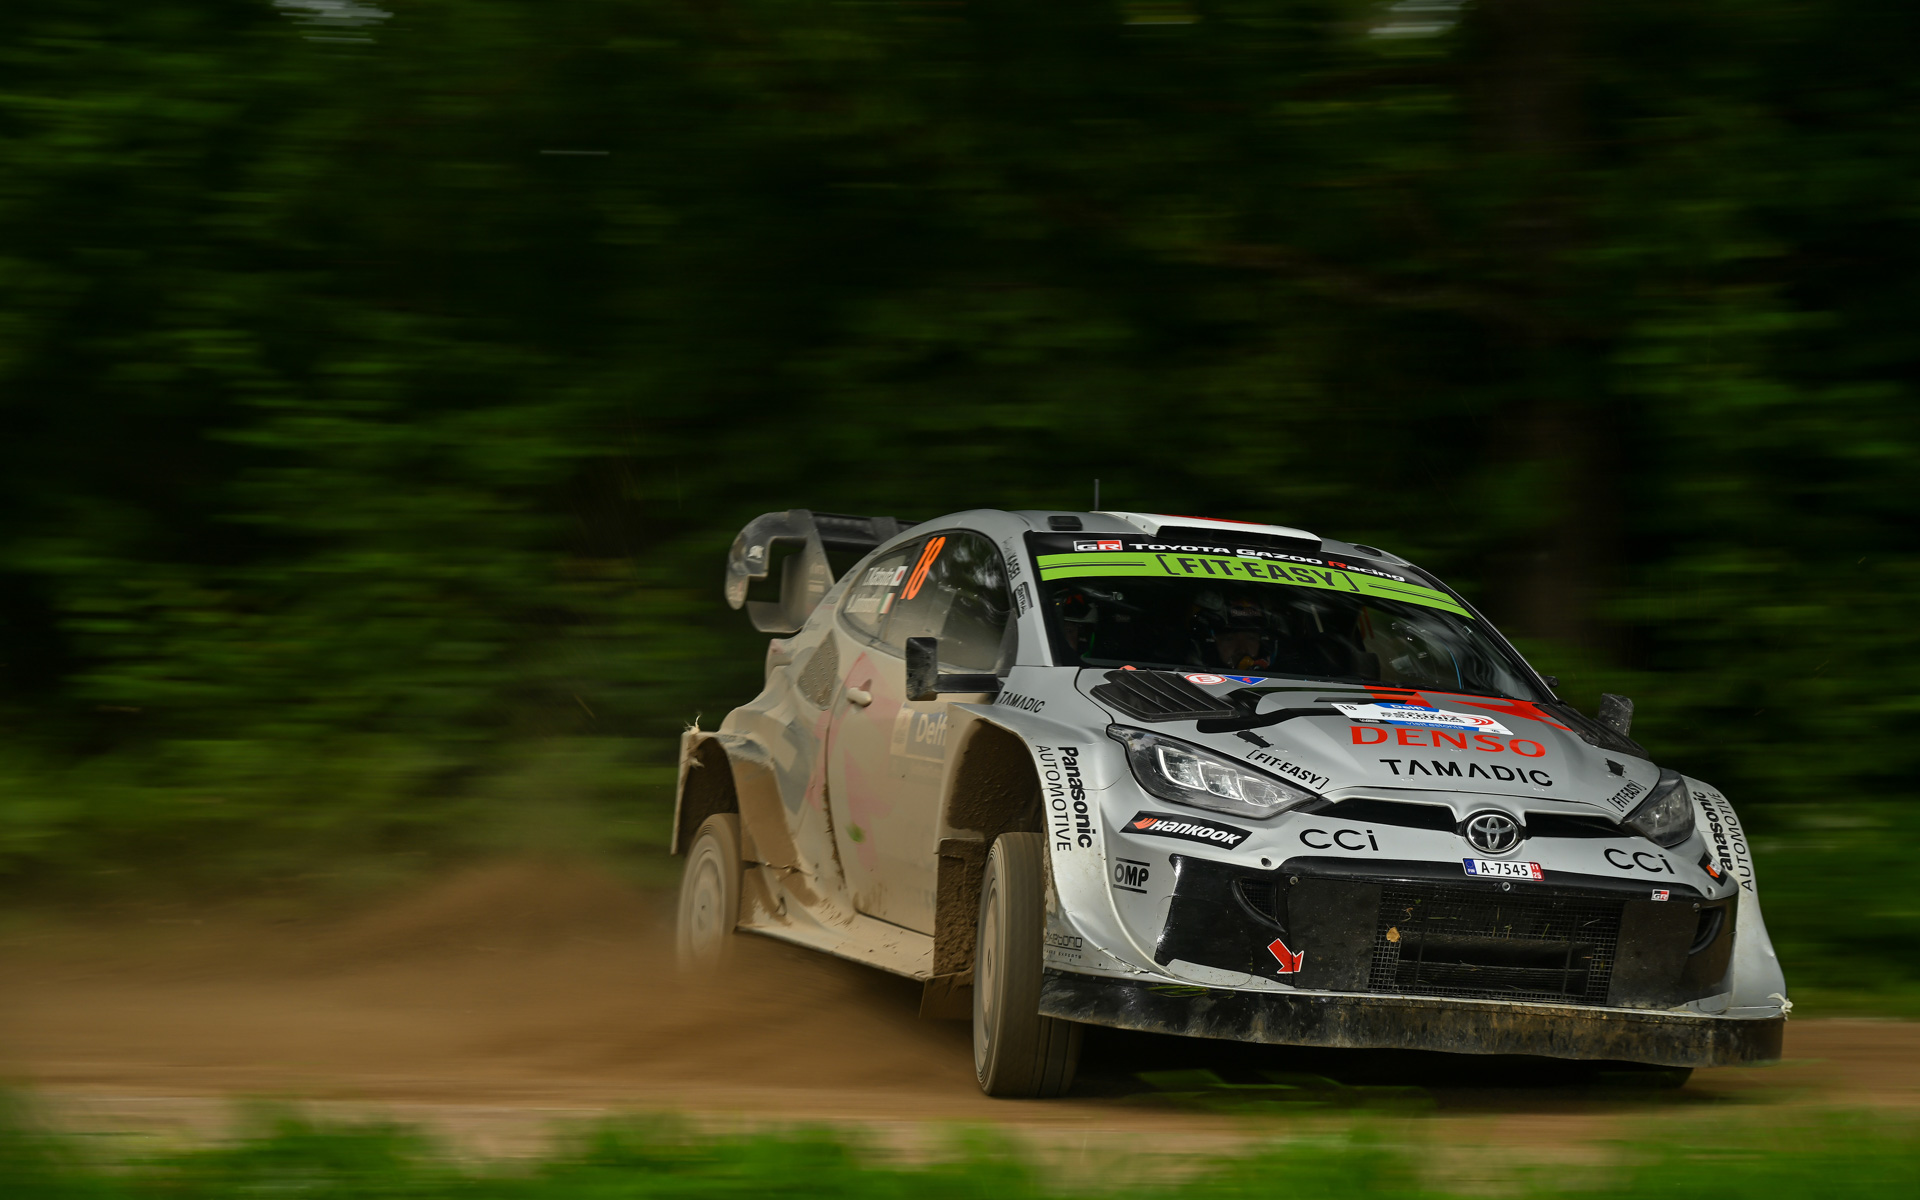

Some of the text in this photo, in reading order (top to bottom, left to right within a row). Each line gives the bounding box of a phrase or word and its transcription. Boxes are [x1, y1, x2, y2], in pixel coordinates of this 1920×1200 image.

[900, 536, 946, 600] 18
[1076, 543, 1406, 583] GR TOYOTA GAZOO Racing
[998, 691, 1046, 713] TAMADIC
[914, 713, 948, 746] Delf
[1349, 725, 1546, 758] DENSO
[1379, 758, 1553, 787] TAMADIC
[1035, 744, 1072, 852] AUTOMOTIVE
[1057, 746, 1097, 849] Panasonic
[1692, 791, 1734, 871] anasonic
[1706, 791, 1754, 892] AUTOMOTIVE
[1113, 863, 1150, 887] OMP
[1481, 861, 1528, 876] A-7545
